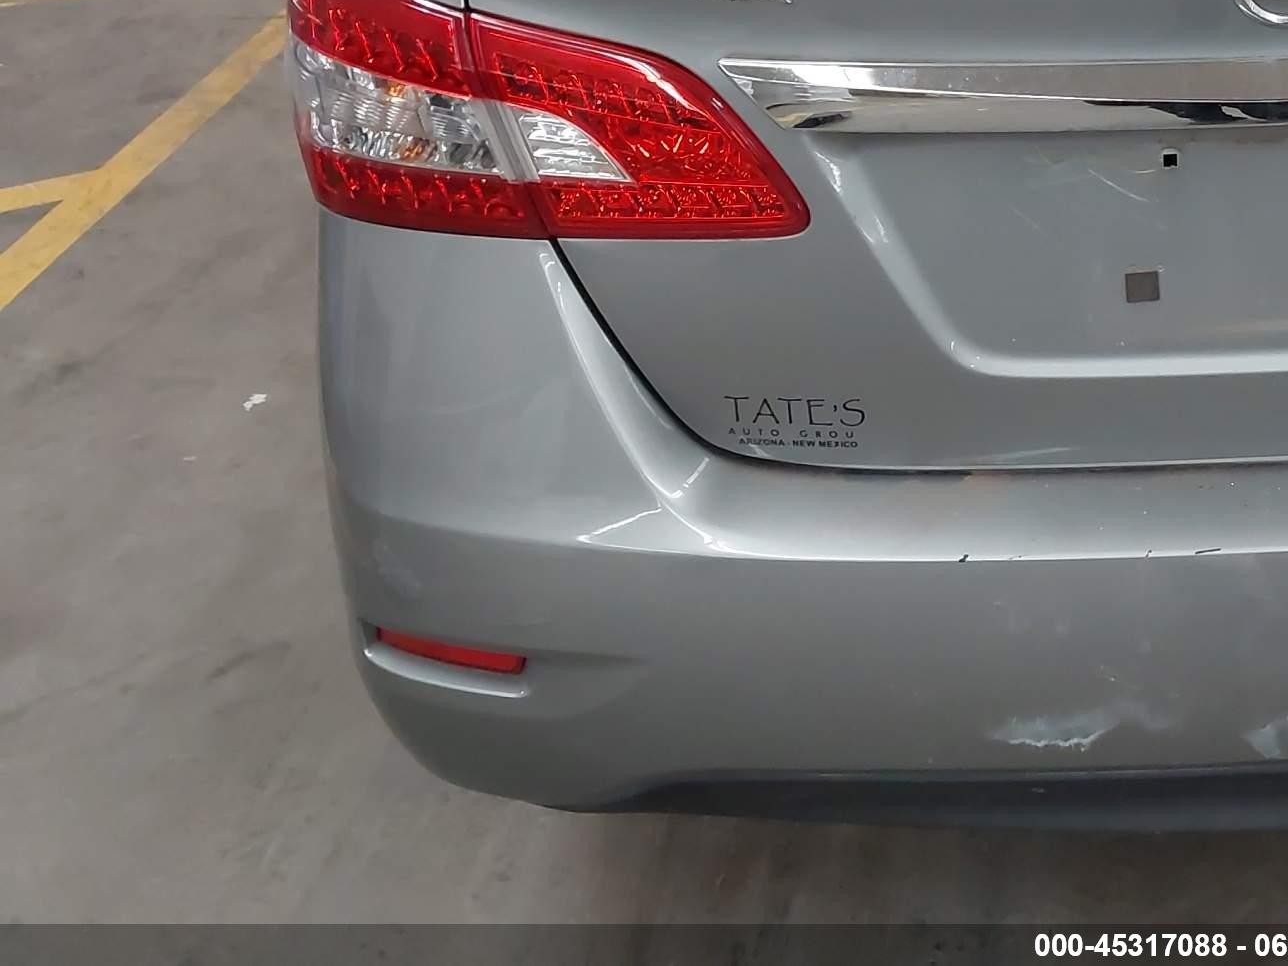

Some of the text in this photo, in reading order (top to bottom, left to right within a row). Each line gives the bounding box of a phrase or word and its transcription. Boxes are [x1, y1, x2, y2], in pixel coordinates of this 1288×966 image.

[724, 395, 866, 427] TATE'S
[728, 427, 780, 437] AUTO
[738, 438, 785, 447] ARIZONA
